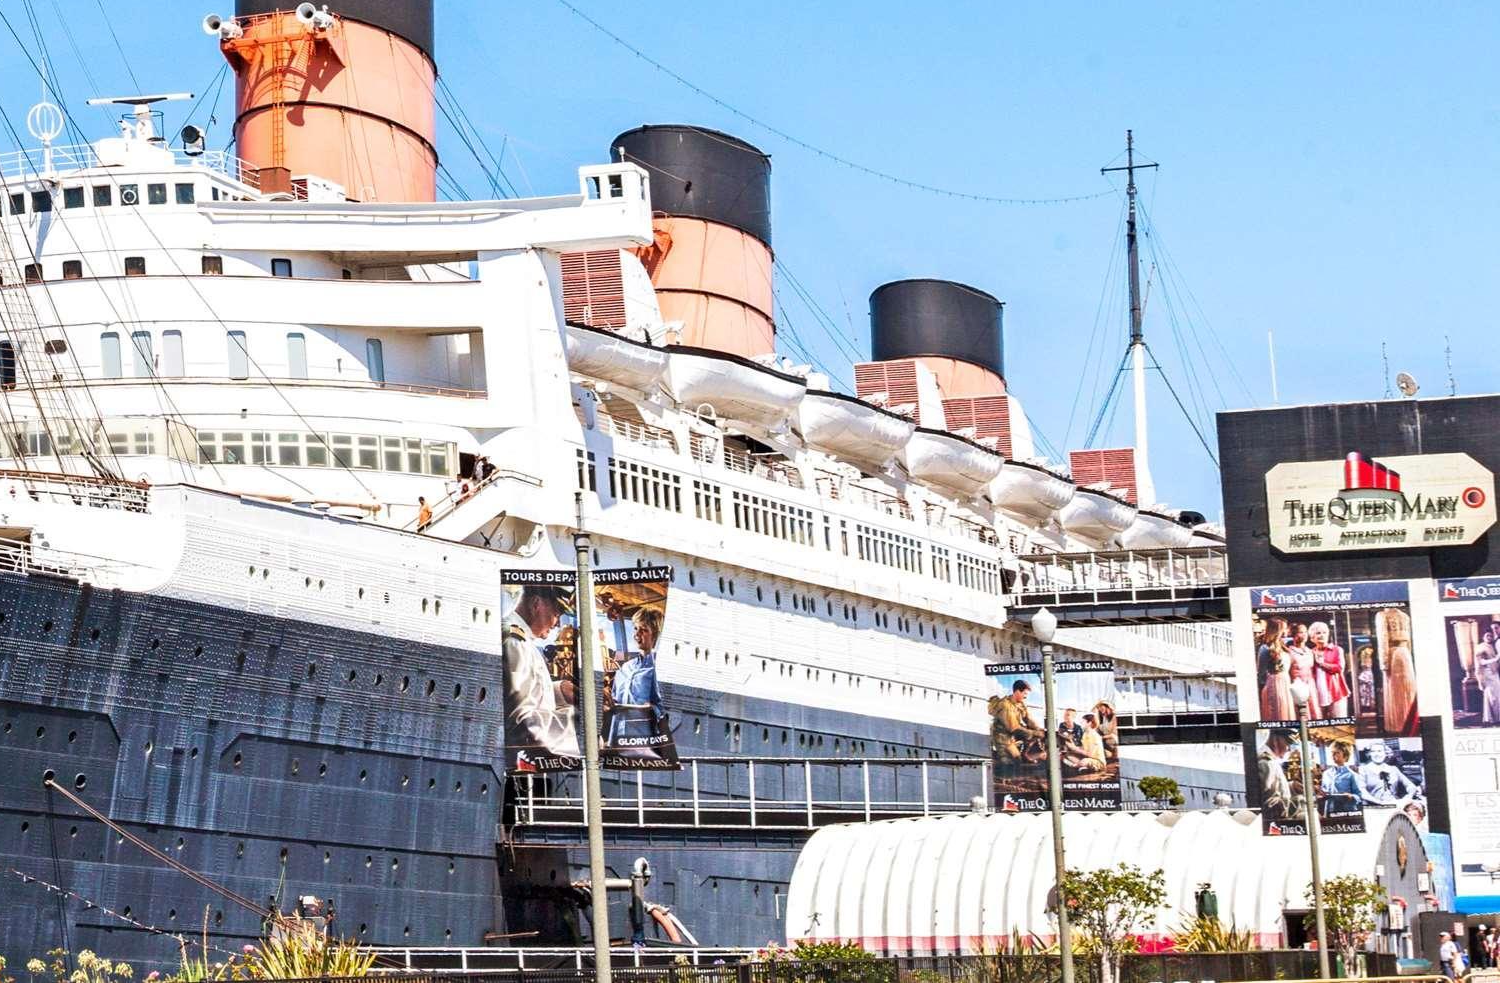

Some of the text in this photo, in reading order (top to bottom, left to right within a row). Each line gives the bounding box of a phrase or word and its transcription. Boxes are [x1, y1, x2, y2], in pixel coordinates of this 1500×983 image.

[1283, 492, 1459, 522] THE QUEEN MARY
[1289, 525, 1466, 542] HOTEL ATTRACTIONS EVENTS
[504, 571, 542, 582] TOURS
[1275, 593, 1294, 604] THE
[1294, 592, 1325, 605] QUEEN
[1325, 590, 1352, 601] MARY
[986, 665, 1016, 673] TOURS
[617, 737, 647, 746] GLORY
[534, 756, 559, 770] THE
[1018, 798, 1036, 810] THE
